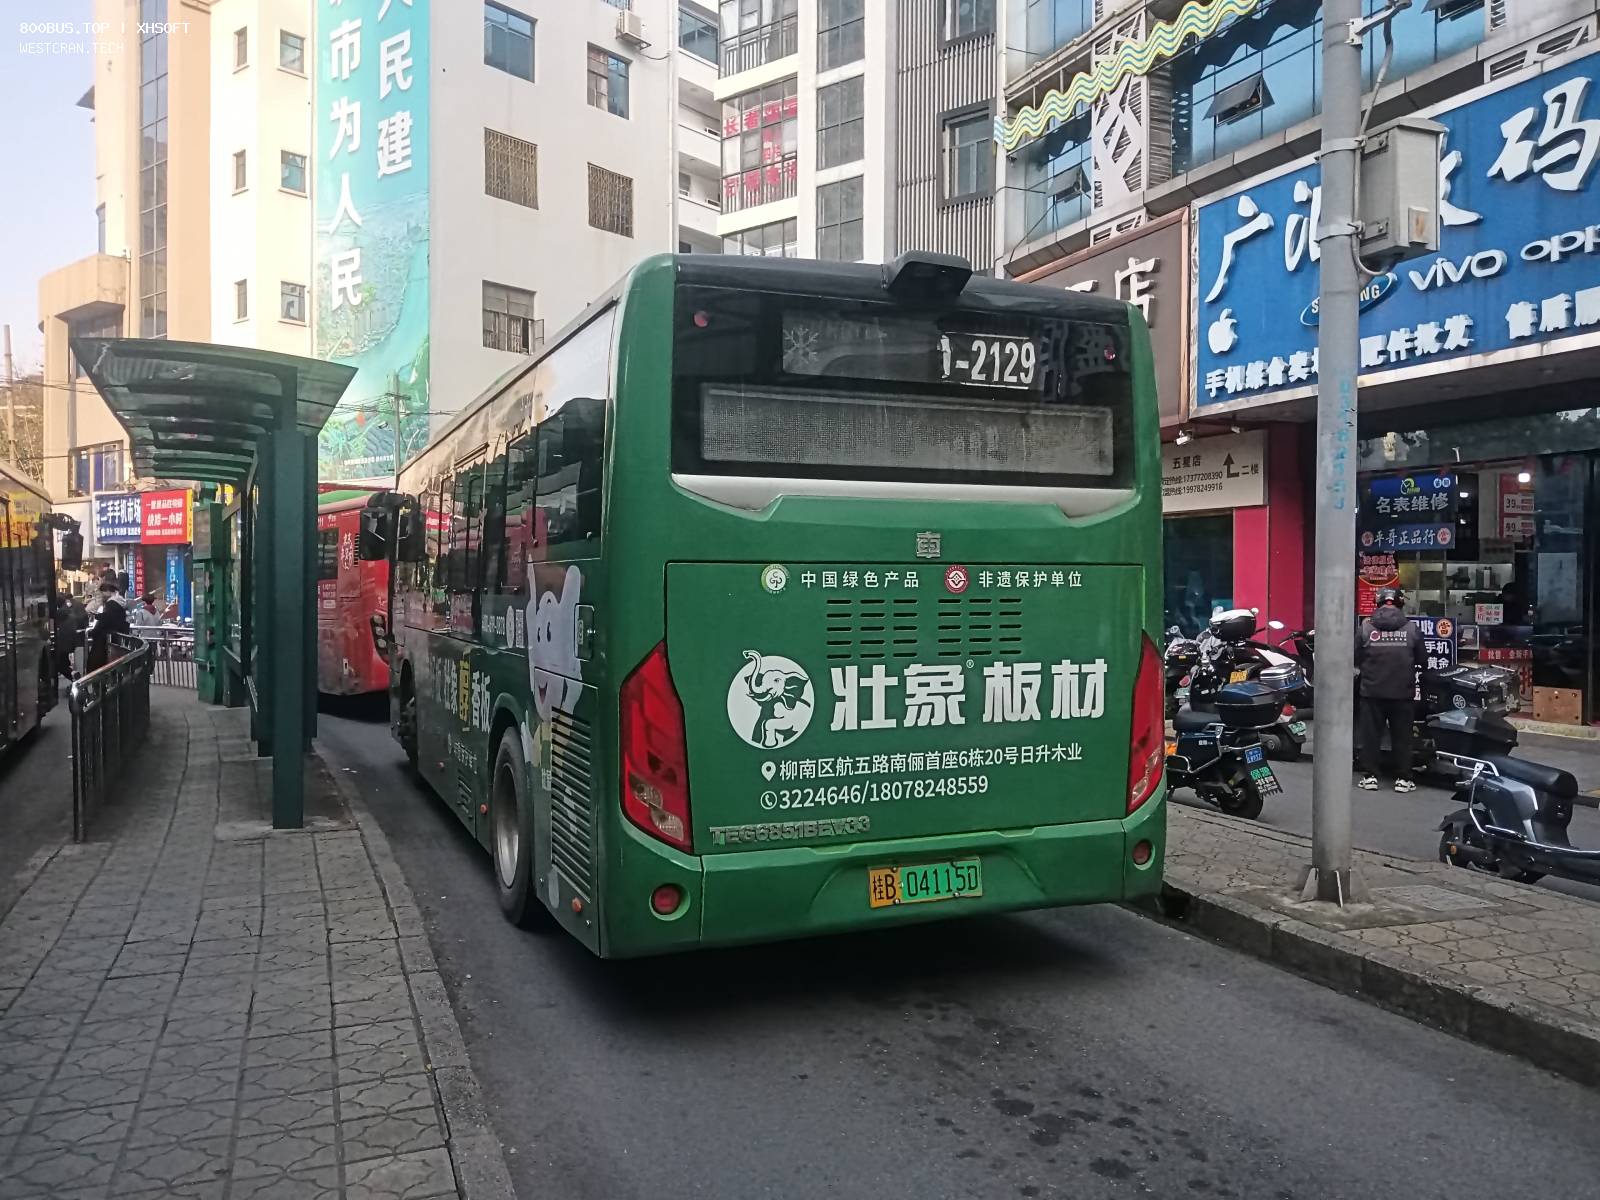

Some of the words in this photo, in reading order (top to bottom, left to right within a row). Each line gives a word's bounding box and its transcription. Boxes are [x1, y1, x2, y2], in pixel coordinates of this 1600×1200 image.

[329, 0, 362, 312] 市为人民
[1408, 249, 1507, 291] vivo
[1375, 492, 1449, 514] 名表维修
[801, 570, 920, 589] 中国绿色产品
[978, 571, 1083, 588] 非遗保护单位
[1424, 640, 1450, 654] 手机
[1427, 656, 1450, 670] 黄金
[779, 742, 1083, 781] 柳南区航五路南俪首座6栋20号日升木业
[779, 774, 990, 810] 3224646/18078248559
[709, 816, 871, 846] TEG6851BEV33
[872, 873, 898, 902] 桂B
